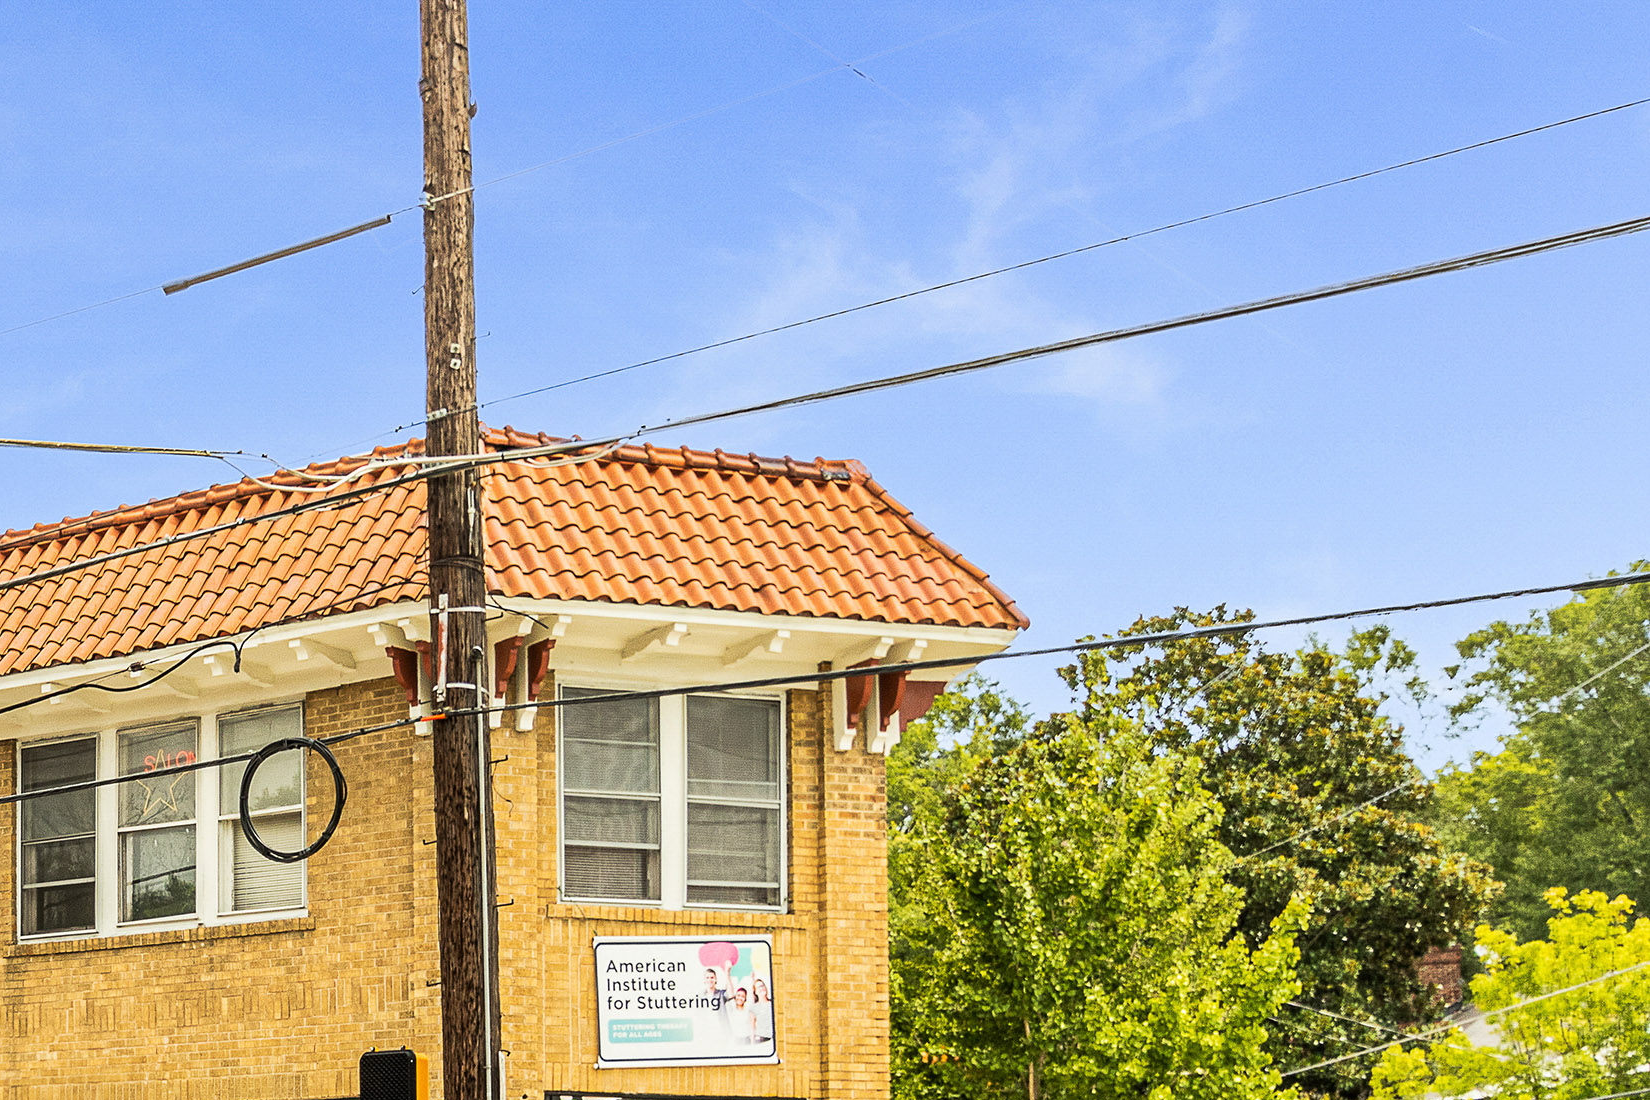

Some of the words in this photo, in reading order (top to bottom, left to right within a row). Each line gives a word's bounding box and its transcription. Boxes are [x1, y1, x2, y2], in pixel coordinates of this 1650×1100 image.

[606, 958, 686, 973] American
[606, 977, 676, 991] Institute
[607, 996, 631, 1010] for
[637, 994, 721, 1011] Stuttering
